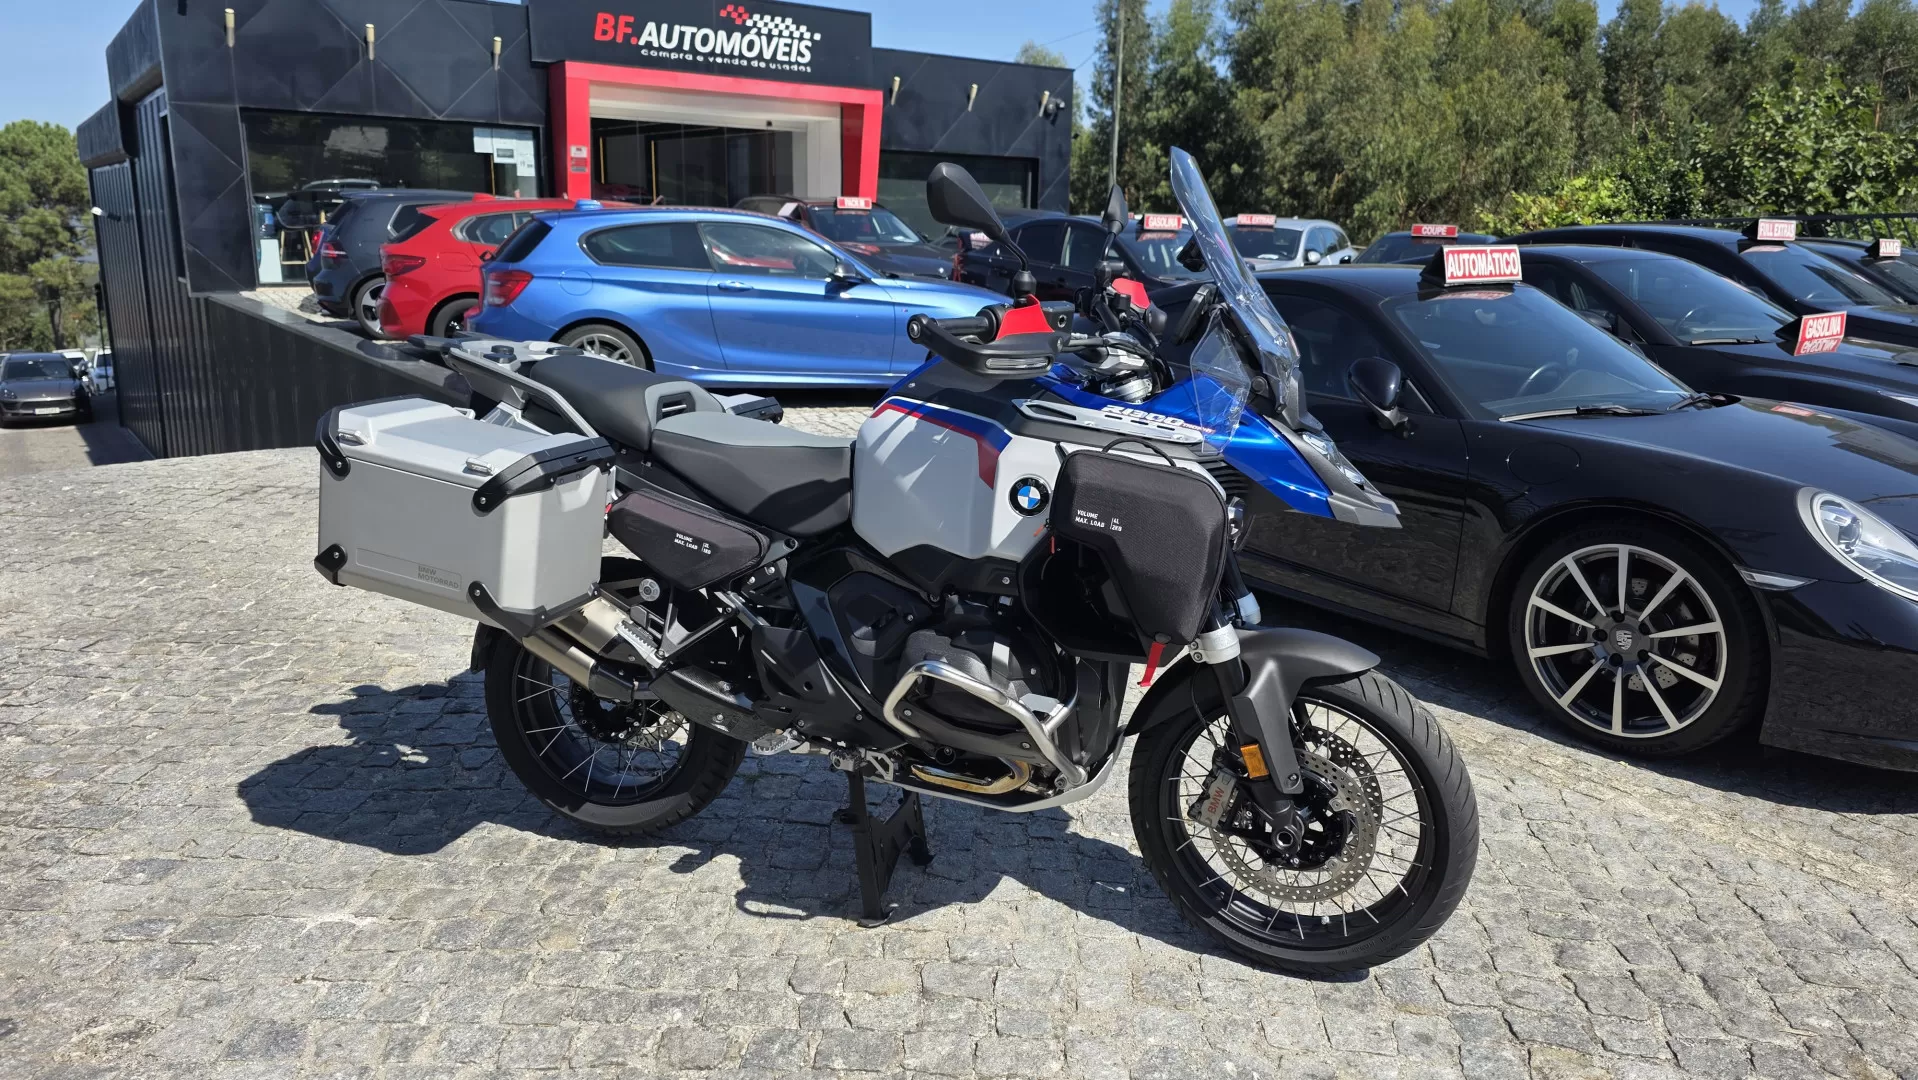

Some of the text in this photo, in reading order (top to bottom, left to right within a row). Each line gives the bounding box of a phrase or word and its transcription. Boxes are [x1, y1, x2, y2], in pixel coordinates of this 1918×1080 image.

[640, 49, 693, 61] compra
[708, 55, 748, 66] venda
[751, 59, 766, 69] de
[770, 63, 812, 73] usados
[1148, 215, 1178, 228] GASOLINA
[1759, 222, 1794, 238] FULL EXTRAS
[1881, 241, 1900, 254] AMG
[1446, 249, 1519, 278] AUTOMÁTICO
[1805, 316, 1841, 339] GASOLINA
[1101, 404, 1185, 427] R1300
[1075, 516, 1089, 525] MAX.
[1090, 519, 1105, 528] LOAD
[1077, 509, 1099, 519] VOLUME
[418, 565, 437, 575] BMW
[418, 573, 459, 589] MOTORRAD
[1208, 787, 1224, 814] BMW
